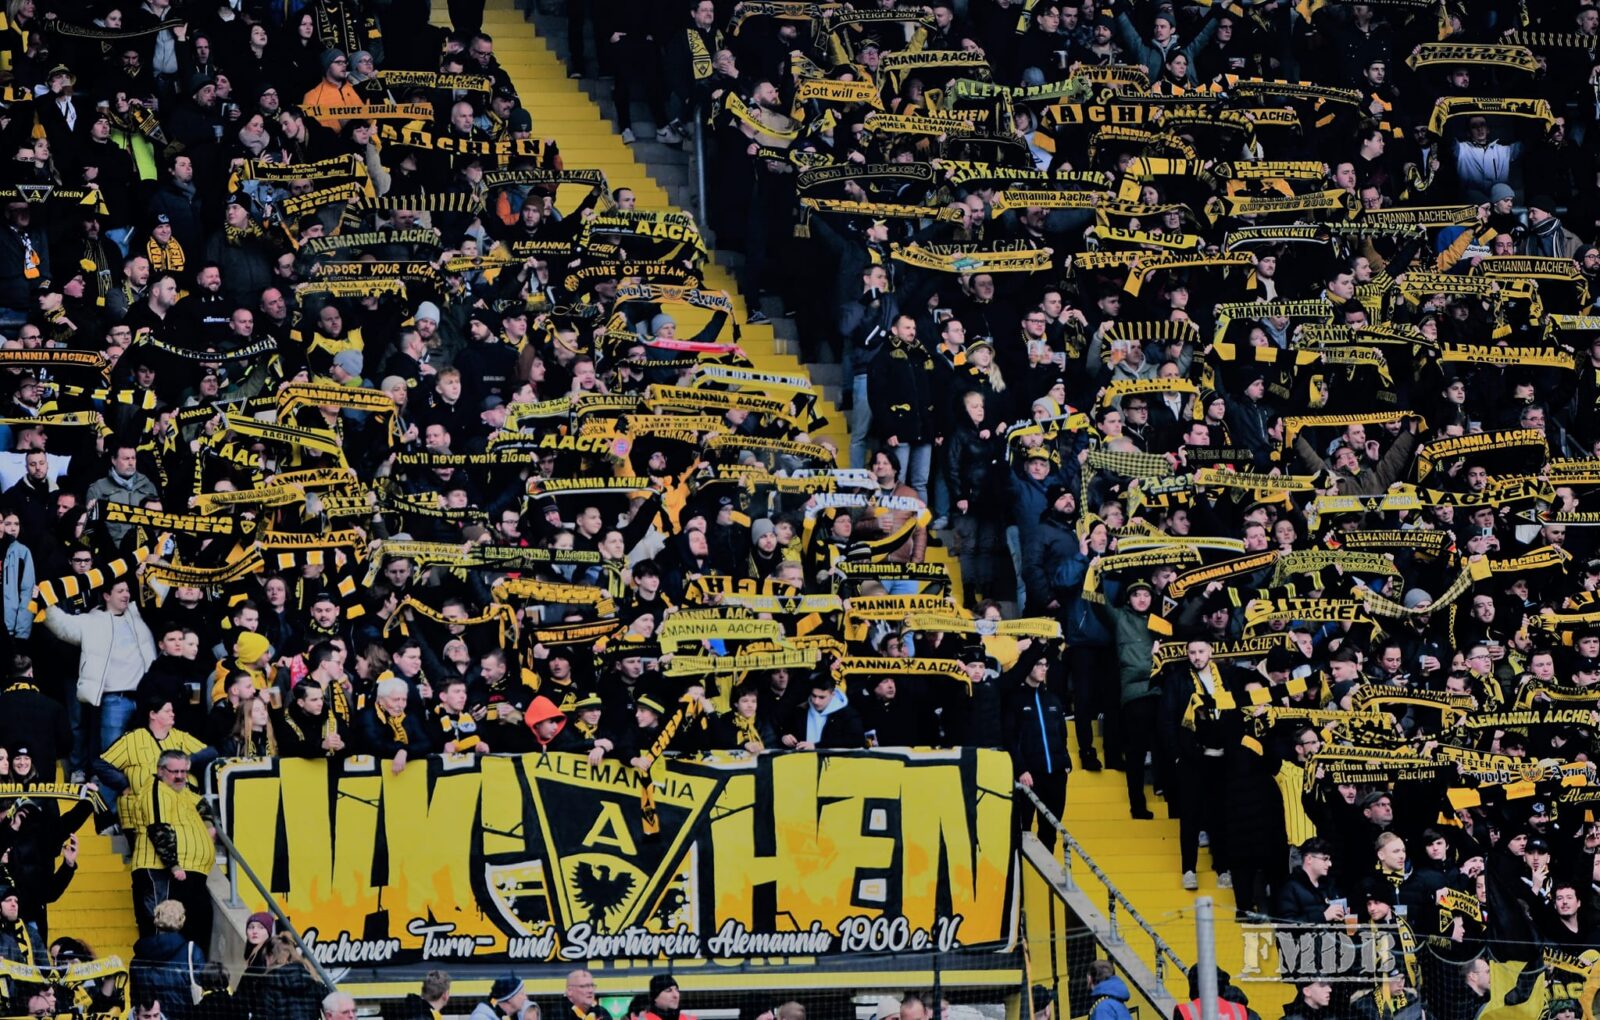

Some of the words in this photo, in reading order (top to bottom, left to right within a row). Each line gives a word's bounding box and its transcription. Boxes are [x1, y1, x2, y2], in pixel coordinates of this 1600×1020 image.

[839, 13, 893, 21] AUFSTEIGER
[882, 52, 937, 67] EMANNIA
[802, 84, 828, 96] Gott
[831, 88, 852, 98] will
[856, 91, 870, 99] es
[329, 104, 362, 115] never
[368, 103, 398, 114] walk
[904, 117, 962, 127] ALEMANNIA
[486, 169, 555, 186] ALEMANNIA
[556, 168, 603, 181] AACHEN
[799, 166, 841, 184] Men
[844, 165, 863, 176] in
[867, 163, 927, 177] Black
[950, 168, 1049, 186] ALEMANNIA
[53, 189, 84, 198] VEREIN
[1003, 190, 1056, 202] Alemannia
[1240, 200, 1300, 212] AUFSTIEG
[1367, 212, 1417, 225] ALEMANNIA
[1418, 210, 1453, 223] AACHEN
[309, 231, 387, 252] ALEMANNIA
[390, 228, 440, 245] AACHEN
[1145, 232, 1185, 244] 1900
[511, 240, 572, 251] ALEMANNIA
[587, 242, 618, 255] CHEN
[922, 241, 978, 254] chwarz
[1089, 255, 1124, 265] BESTEN
[1132, 252, 1204, 280] ALEMANNIA
[1482, 261, 1533, 273] ALEMANNIA
[318, 263, 362, 276] UPPORT
[370, 262, 400, 275] YOUR
[577, 265, 617, 280] FUTURE
[622, 264, 640, 276] OF
[645, 265, 686, 278] DREAM
[1284, 303, 1332, 317] AACHEN
[1443, 341, 1556, 359] LEMANNIA
[52, 352, 99, 363] AACHEN
[1466, 355, 1521, 364] AACHEN
[1115, 384, 1172, 394] AACHEN
[525, 401, 547, 411] SIND
[550, 397, 570, 408] AAC
[660, 388, 730, 404] ALEMANNIA
[736, 396, 785, 412] AACHEN
[179, 406, 213, 420] MINGE
[262, 430, 302, 443] AACHEN
[395, 450, 429, 465] You'll
[432, 453, 467, 465] never
[469, 451, 497, 464] walk
[543, 476, 606, 490] ALEMANNIA
[607, 475, 651, 488] AACHEN
[815, 492, 867, 507] MANNIA
[105, 510, 234, 535] AACHEN
[1555, 511, 1600, 522] ALEMANN
[1345, 533, 1403, 544] ALEMANNIA
[1403, 532, 1444, 544] AACHEN
[399, 544, 430, 553] NEVER
[432, 545, 463, 554] WALK
[837, 561, 903, 575] Alemannia
[1301, 555, 1338, 566] FOR
[1341, 557, 1390, 568] GOAL
[1158, 641, 1229, 660] ALEMNIA
[1231, 636, 1283, 652] AACHEN
[841, 661, 902, 670] MANNIA
[1355, 684, 1409, 702] ALEMANNIA
[1332, 771, 1389, 784] Alemannia
[1397, 769, 1436, 781] Aachen
[28, 782, 80, 794] AACHEN
[582, 802, 638, 855] A
[297, 930, 400, 964] Aachener
[407, 919, 495, 961] Turn-
[507, 927, 556, 960] und
[561, 922, 700, 960] Sportverein
[708, 919, 831, 957] Alemannia
[837, 916, 911, 952] 1900
